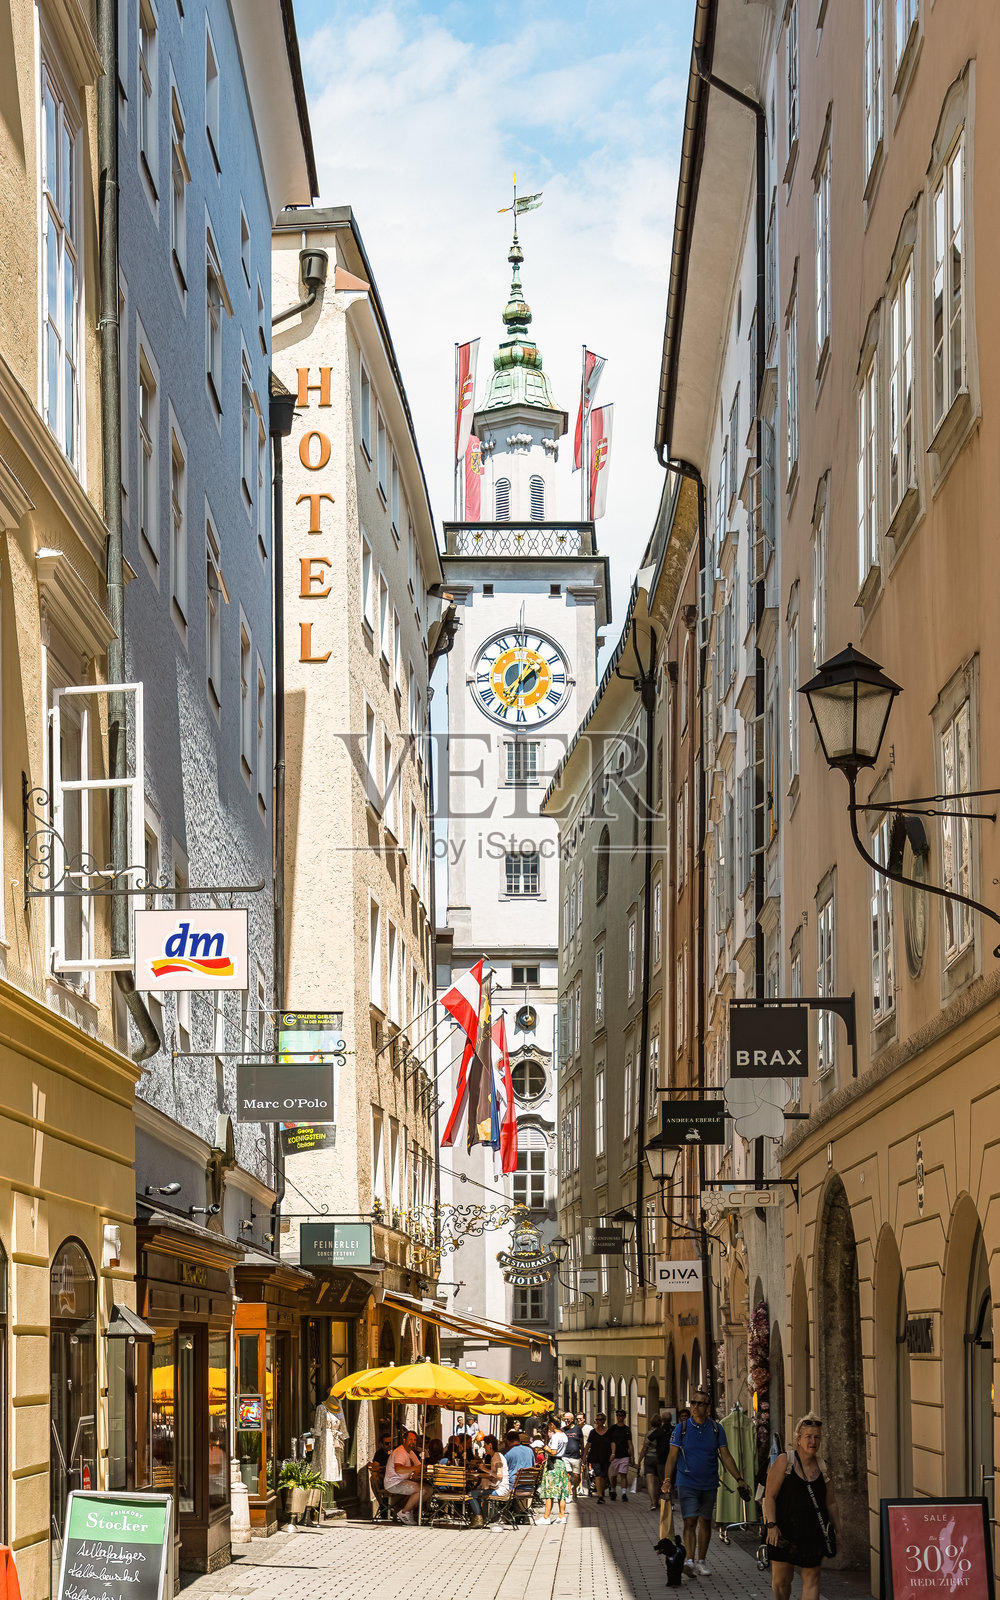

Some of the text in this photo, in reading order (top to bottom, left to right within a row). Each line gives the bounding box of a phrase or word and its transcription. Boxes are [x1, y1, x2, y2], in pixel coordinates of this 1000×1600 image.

[296, 367, 335, 663] HOTEL
[165, 923, 225, 958] dm
[736, 1049, 802, 1066] BRAX
[243, 1098, 328, 1109] Marc O'Polo
[288, 1132, 327, 1144] KOENIGSTEIN
[313, 1240, 359, 1249] FEINERLEI
[500, 1255, 552, 1269] RESTAURANT
[508, 1274, 547, 1285] HOTEL
[659, 1268, 698, 1280] DIVA
[86, 1512, 149, 1532] Stocker
[923, 1514, 948, 1522] SALE
[905, 1545, 972, 1573] 30%
[910, 1577, 971, 1587] REDUZIERT
